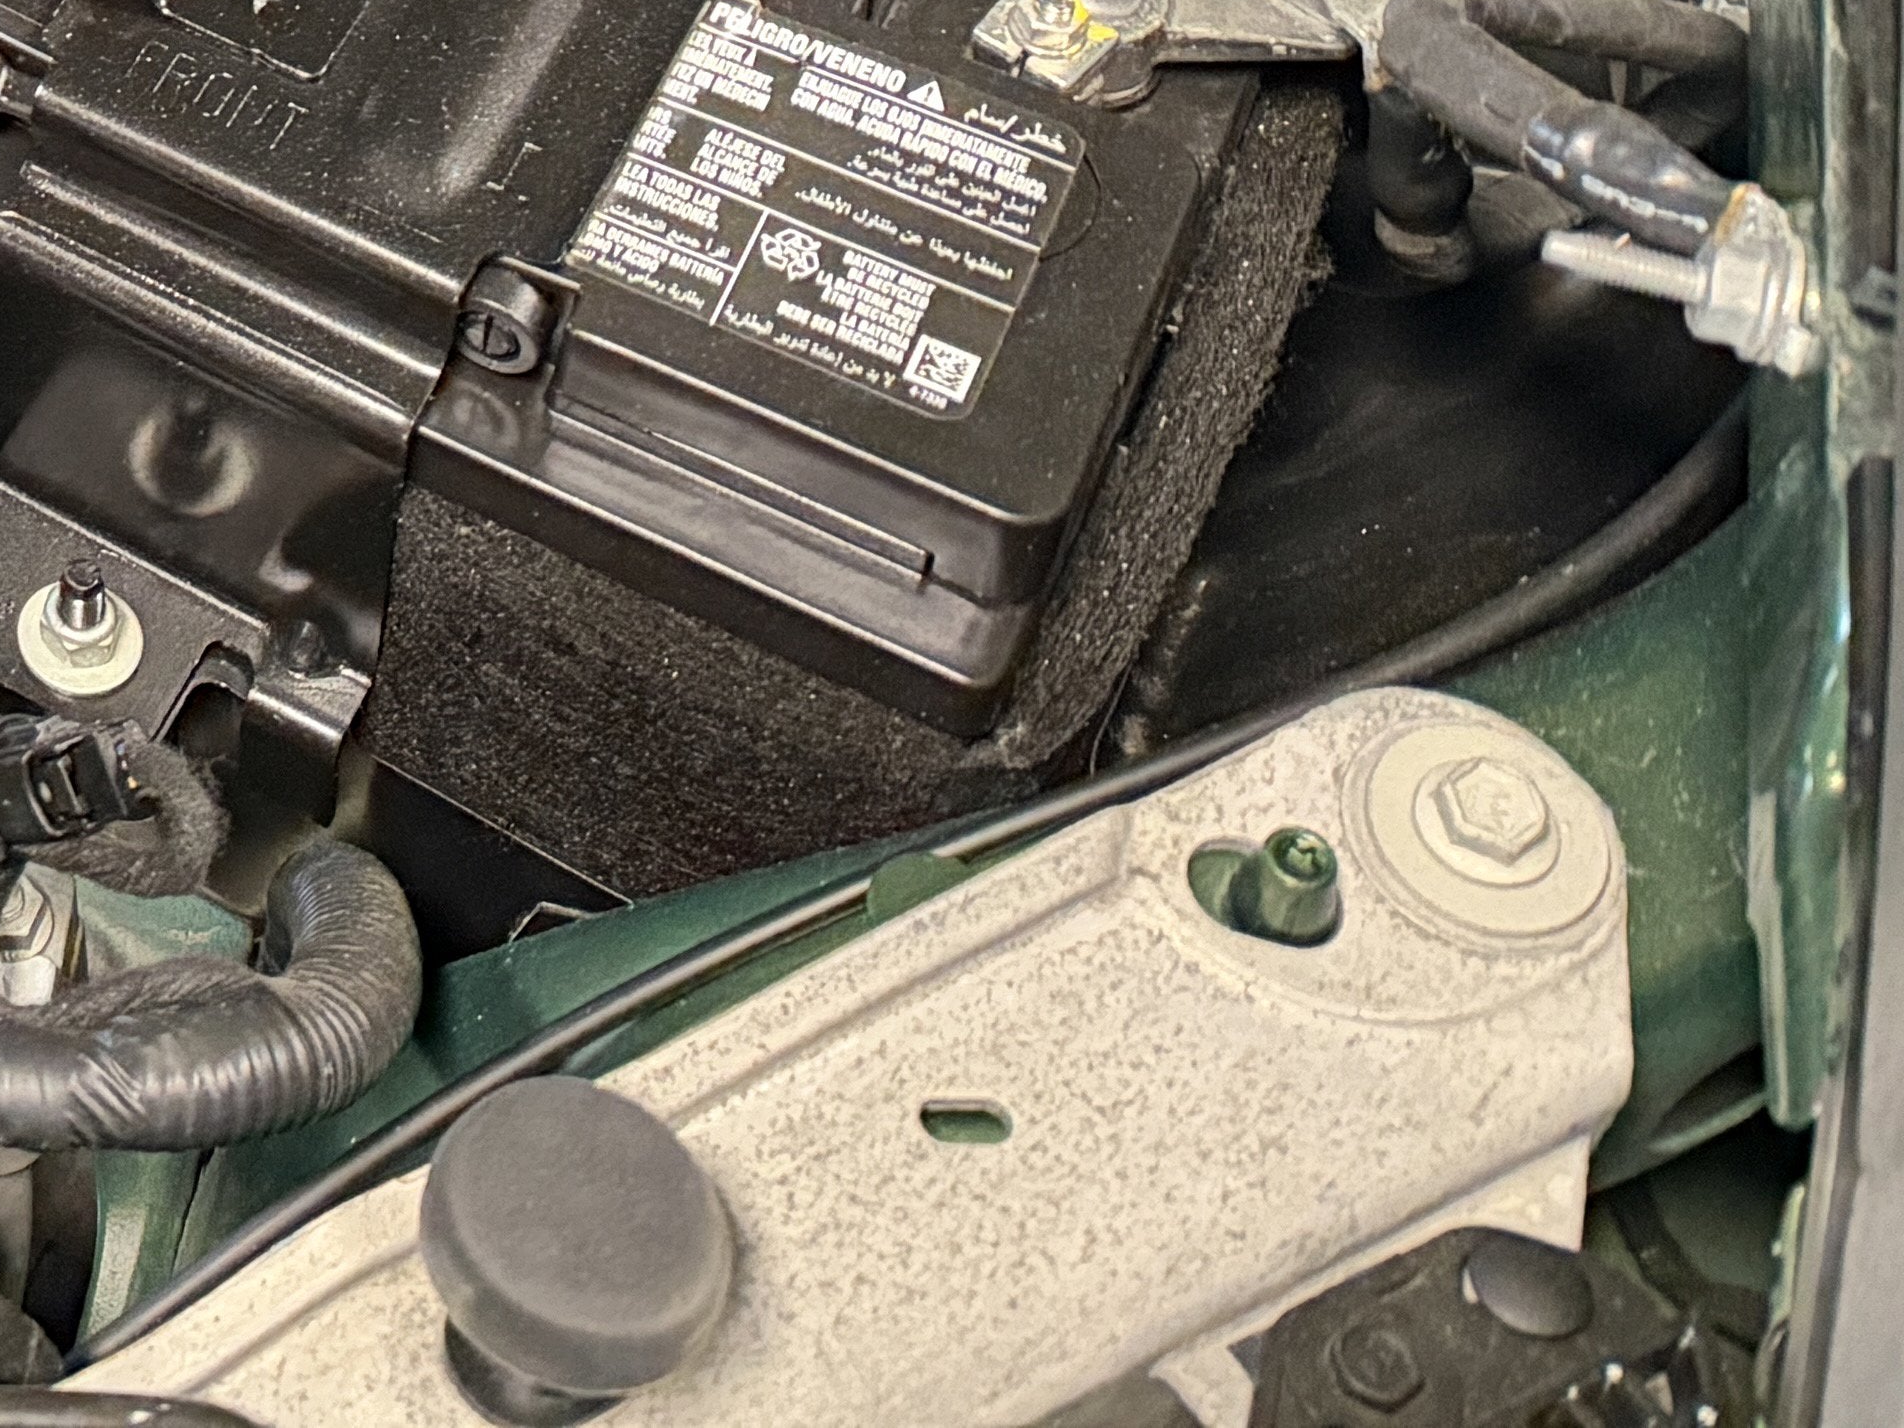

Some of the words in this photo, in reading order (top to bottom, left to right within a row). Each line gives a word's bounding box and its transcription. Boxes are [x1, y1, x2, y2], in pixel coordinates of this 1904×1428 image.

[706, 0, 909, 94] PELIGRO/VENENO
[123, 42, 310, 151] FRONT
[858, 95, 890, 119] LOS
[884, 104, 922, 131] OJOS
[703, 125, 764, 161] ALÉJESE
[787, 87, 821, 112] CON
[853, 113, 904, 145] ACUDA
[898, 129, 951, 164] RÁPIDO
[945, 148, 979, 175] CON
[974, 159, 996, 181] EL
[619, 160, 653, 184] LEA
[647, 171, 696, 201] TODAS
[690, 188, 722, 212] LAS
[687, 156, 721, 180] LOS
[695, 141, 759, 177] ALCANCE
[755, 164, 779, 185] DE
[813, 268, 837, 290] LA
[840, 248, 900, 283] BATTERY
[896, 271, 937, 298] MUST
[844, 265, 868, 284] BE
[864, 274, 931, 311] RECYCLED
[774, 299, 812, 326] DEBE
[807, 312, 838, 336] SER
[833, 324, 907, 366] RECICLADA
[837, 311, 860, 329] LA
